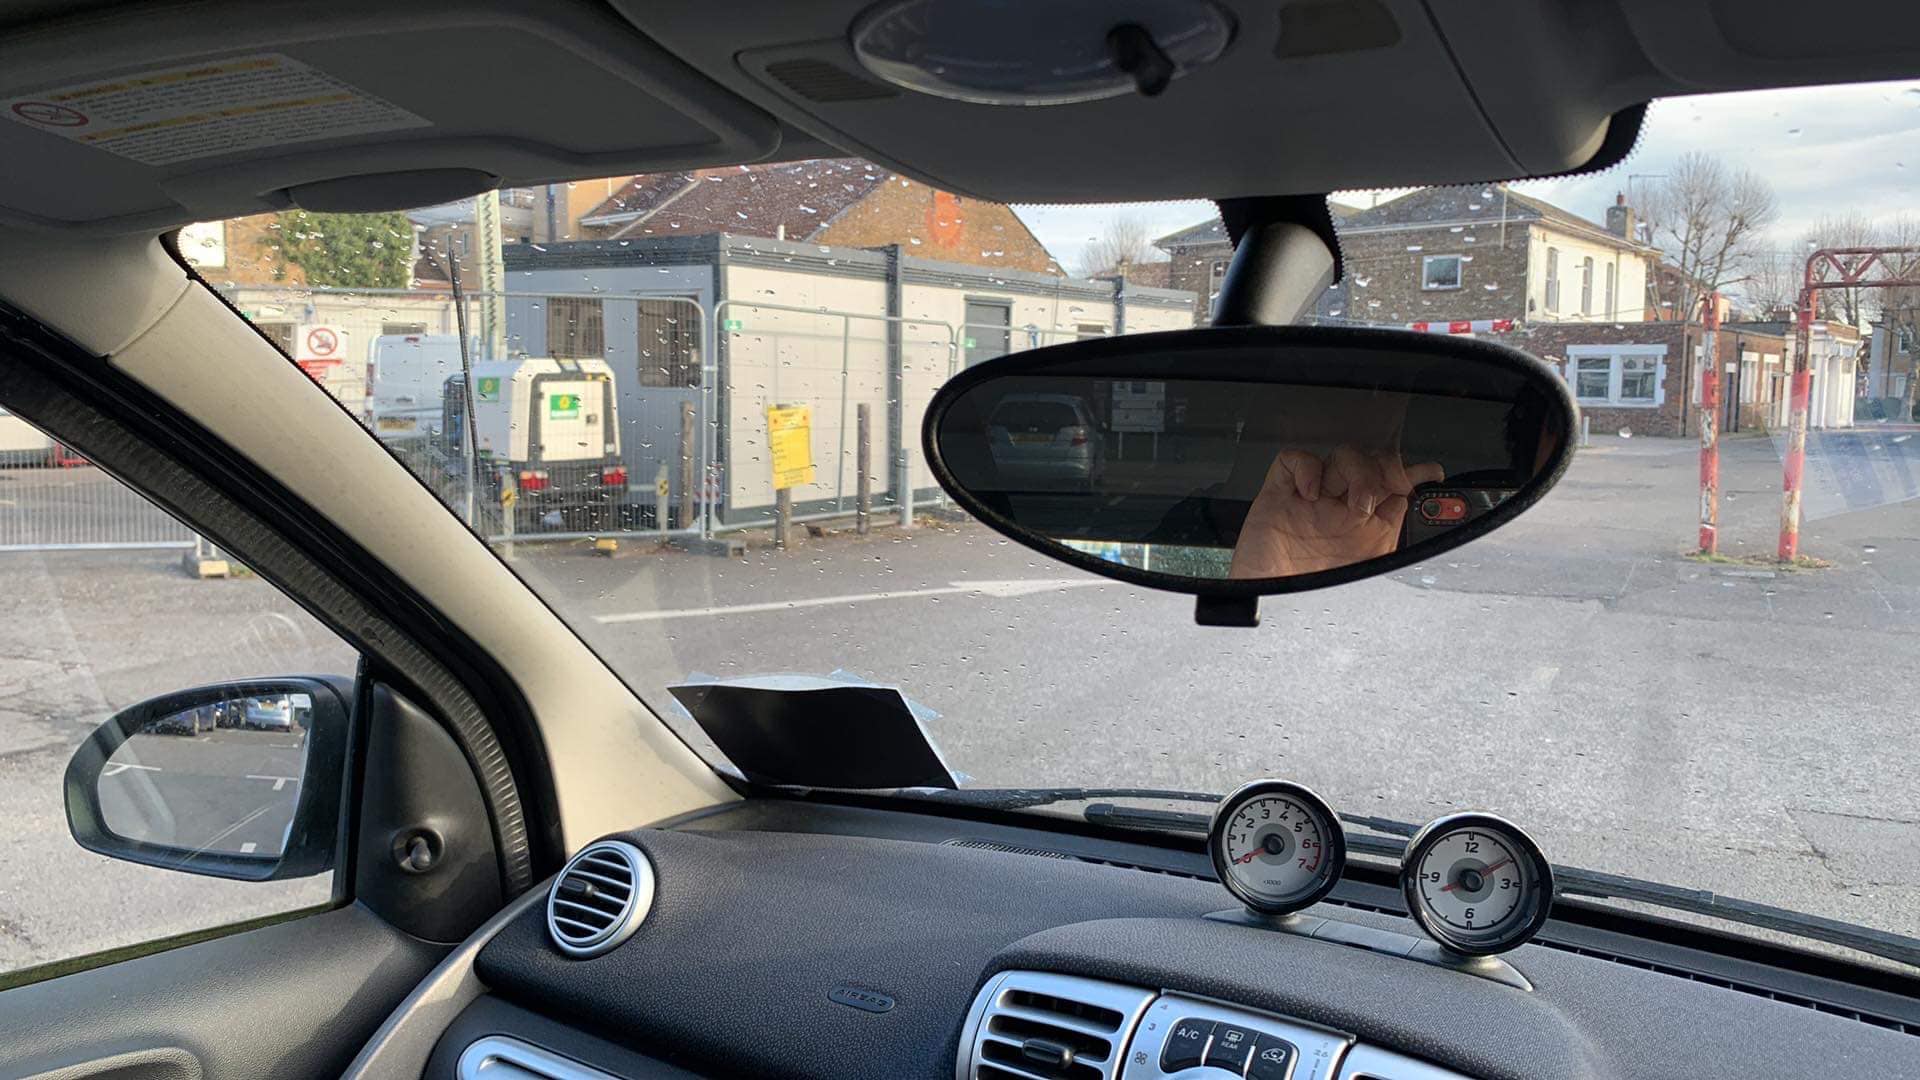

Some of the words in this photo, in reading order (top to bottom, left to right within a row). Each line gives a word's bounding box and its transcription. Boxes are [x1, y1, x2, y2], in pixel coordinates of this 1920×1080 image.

[1261, 809, 1270, 819] 3
[1279, 811, 1289, 821] 4
[1246, 818, 1255, 828] 2
[1295, 822, 1303, 832] 5
[1241, 834, 1246, 844] 1
[1303, 839, 1311, 849] 6
[1465, 842, 1479, 853] 12
[1298, 859, 1306, 869] 7
[1430, 872, 1440, 882] 9
[1500, 878, 1511, 889] 3
[1464, 908, 1474, 919] 6
[1177, 1028, 1200, 1040] A/C
